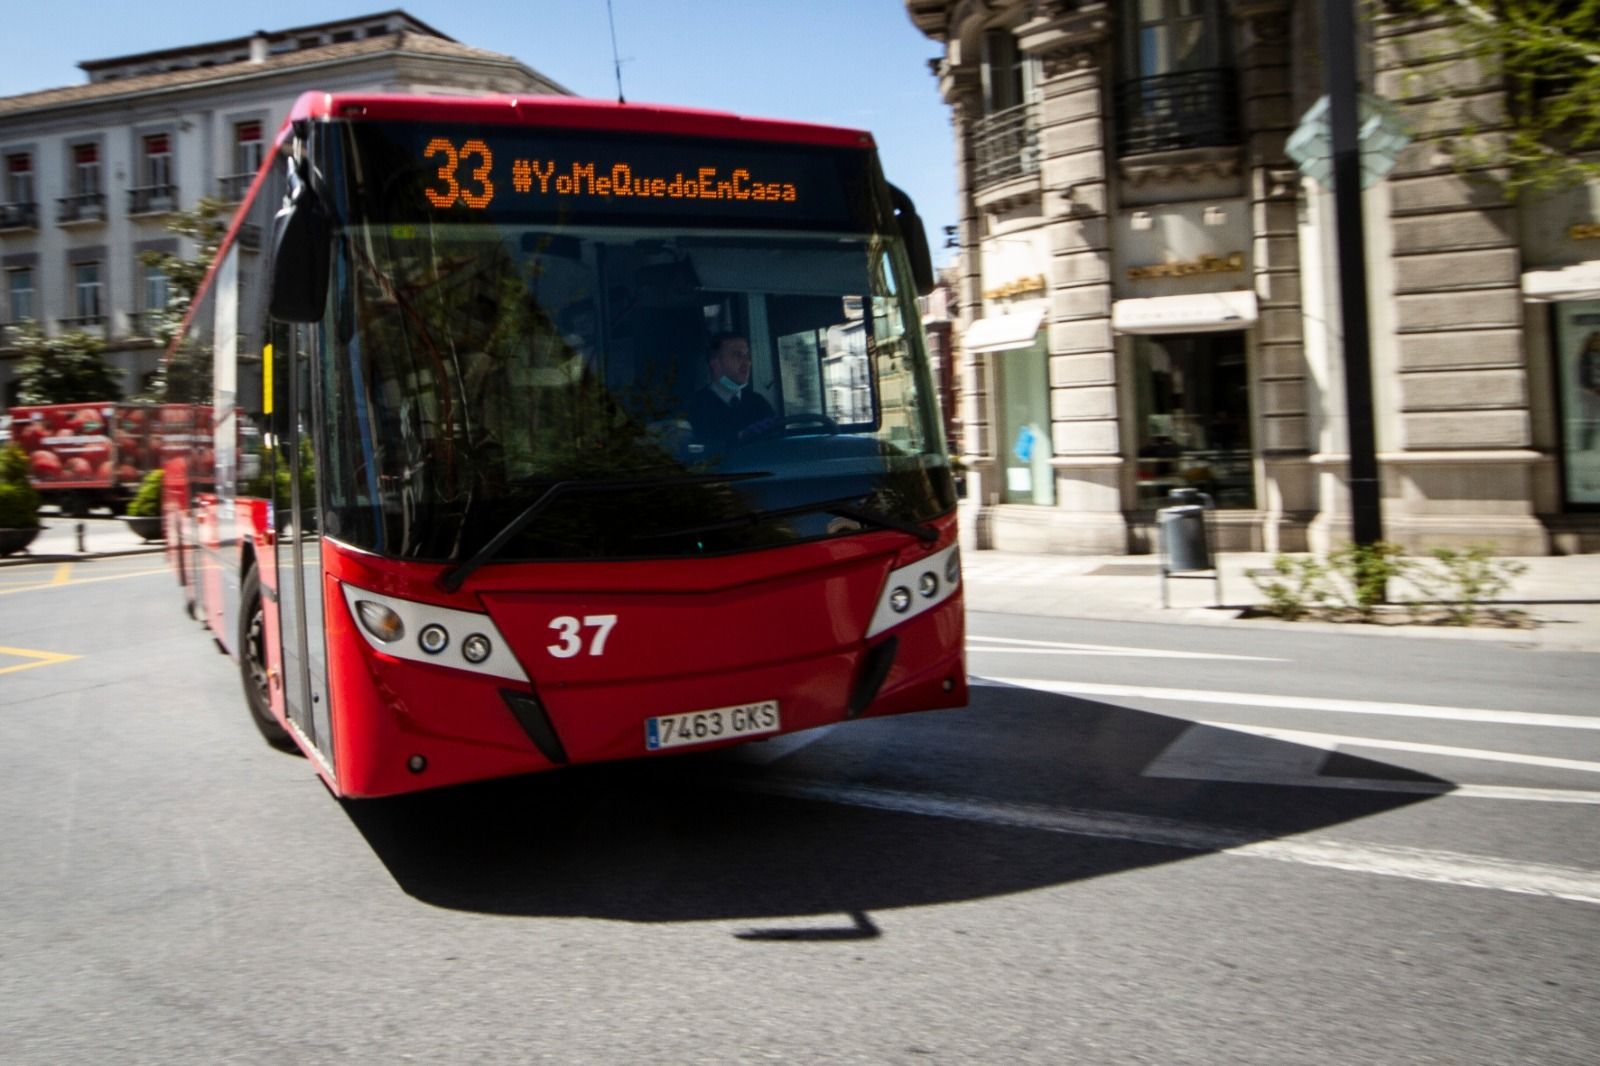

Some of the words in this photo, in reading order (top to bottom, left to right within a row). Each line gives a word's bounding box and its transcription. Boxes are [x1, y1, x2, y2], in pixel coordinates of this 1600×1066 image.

[424, 138, 494, 209] 33
[512, 159, 797, 201] #YoMeQuedoEnCasa
[547, 614, 618, 658] 37
[660, 712, 724, 744] 7463
[731, 703, 776, 732] GKS
